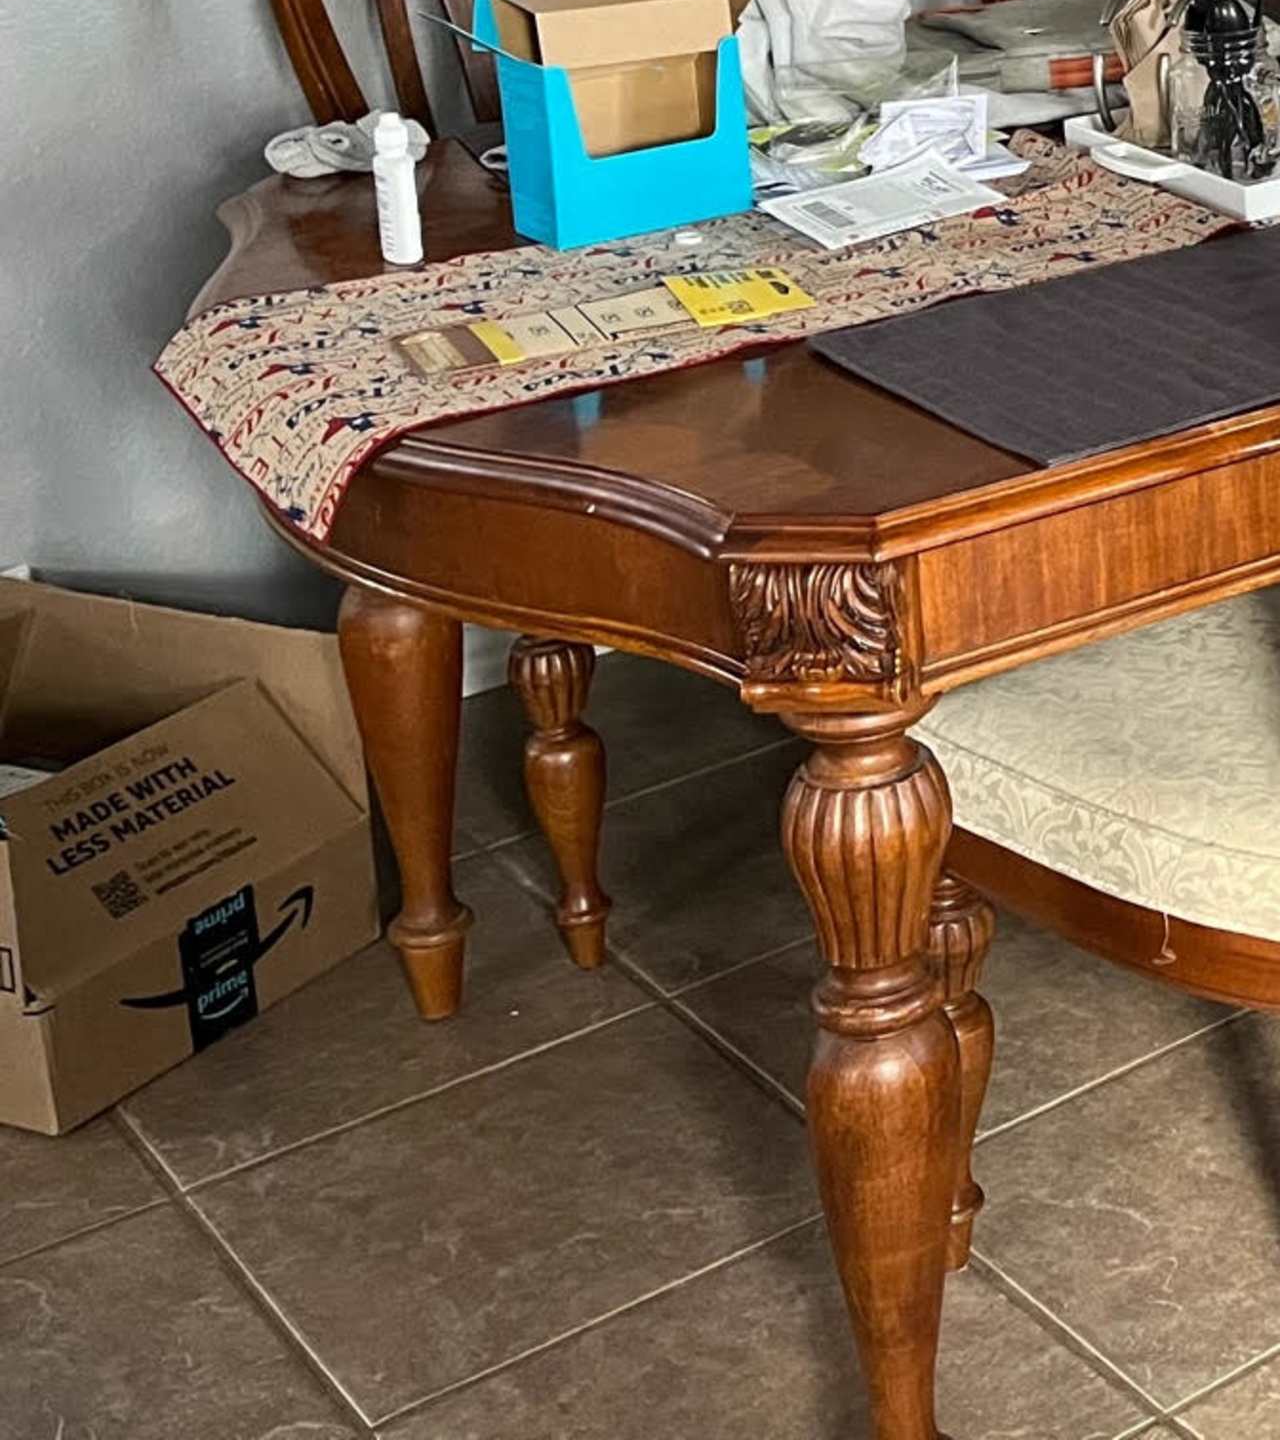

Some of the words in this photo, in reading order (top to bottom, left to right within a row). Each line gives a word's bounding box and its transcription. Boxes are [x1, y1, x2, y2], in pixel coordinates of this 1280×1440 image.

[46, 834, 111, 875] LESS
[110, 769, 236, 842] MATERIAL
[50, 792, 129, 842] MADE
[126, 757, 198, 800] WITH
[193, 892, 245, 935] prime
[197, 970, 248, 1013] prime
